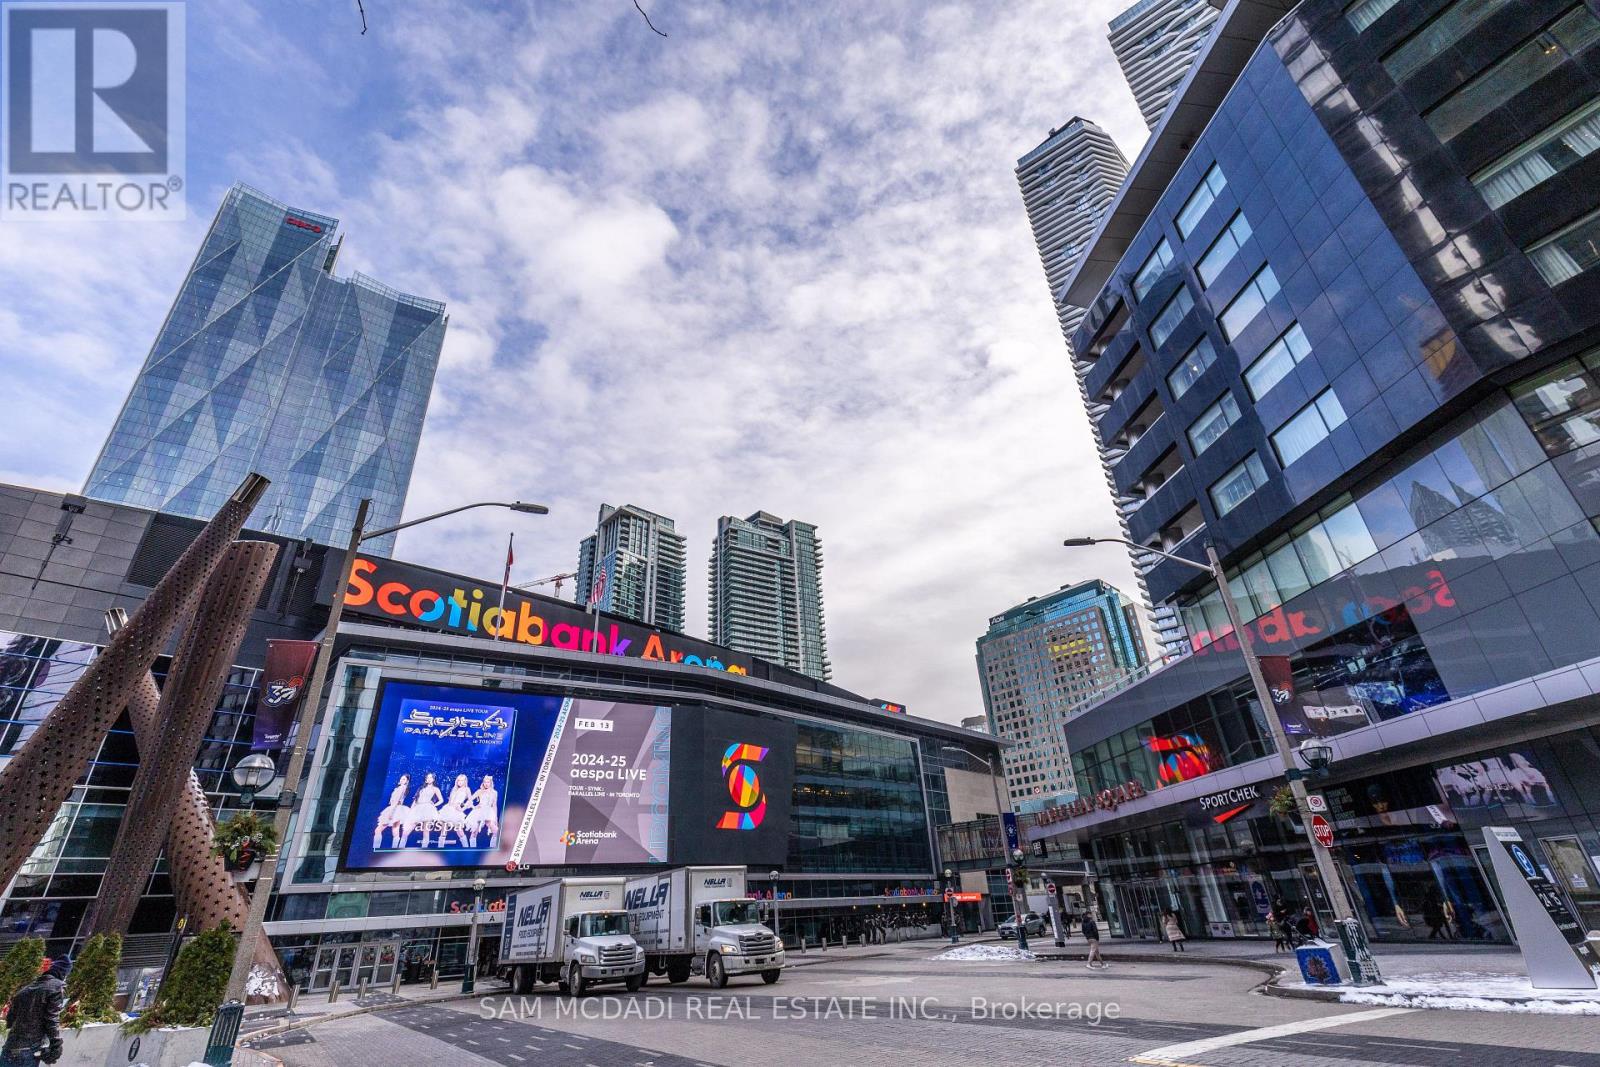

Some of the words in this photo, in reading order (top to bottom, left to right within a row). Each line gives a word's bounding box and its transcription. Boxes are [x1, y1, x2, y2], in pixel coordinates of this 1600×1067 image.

[344, 557, 632, 657] Scotiabank
[571, 753, 626, 767] 2024-25
[570, 768, 615, 781] aespa
[617, 768, 647, 781] LIVE
[521, 803, 537, 834] PARALLEL
[533, 787, 542, 801] LINE
[542, 744, 556, 774] TORONTO
[576, 830, 617, 839] Scotiabank
[1313, 824, 1331, 837] STOP
[518, 862, 530, 870] LG
[704, 878, 726, 886] NELLA
[580, 890, 603, 898] NELLA
[624, 882, 669, 910] NELLA
[884, 887, 919, 897] Scotiabank
[920, 887, 938, 897] Arena
[517, 900, 551, 928] NELLA
[639, 909, 664, 921] EQUIPMENT
